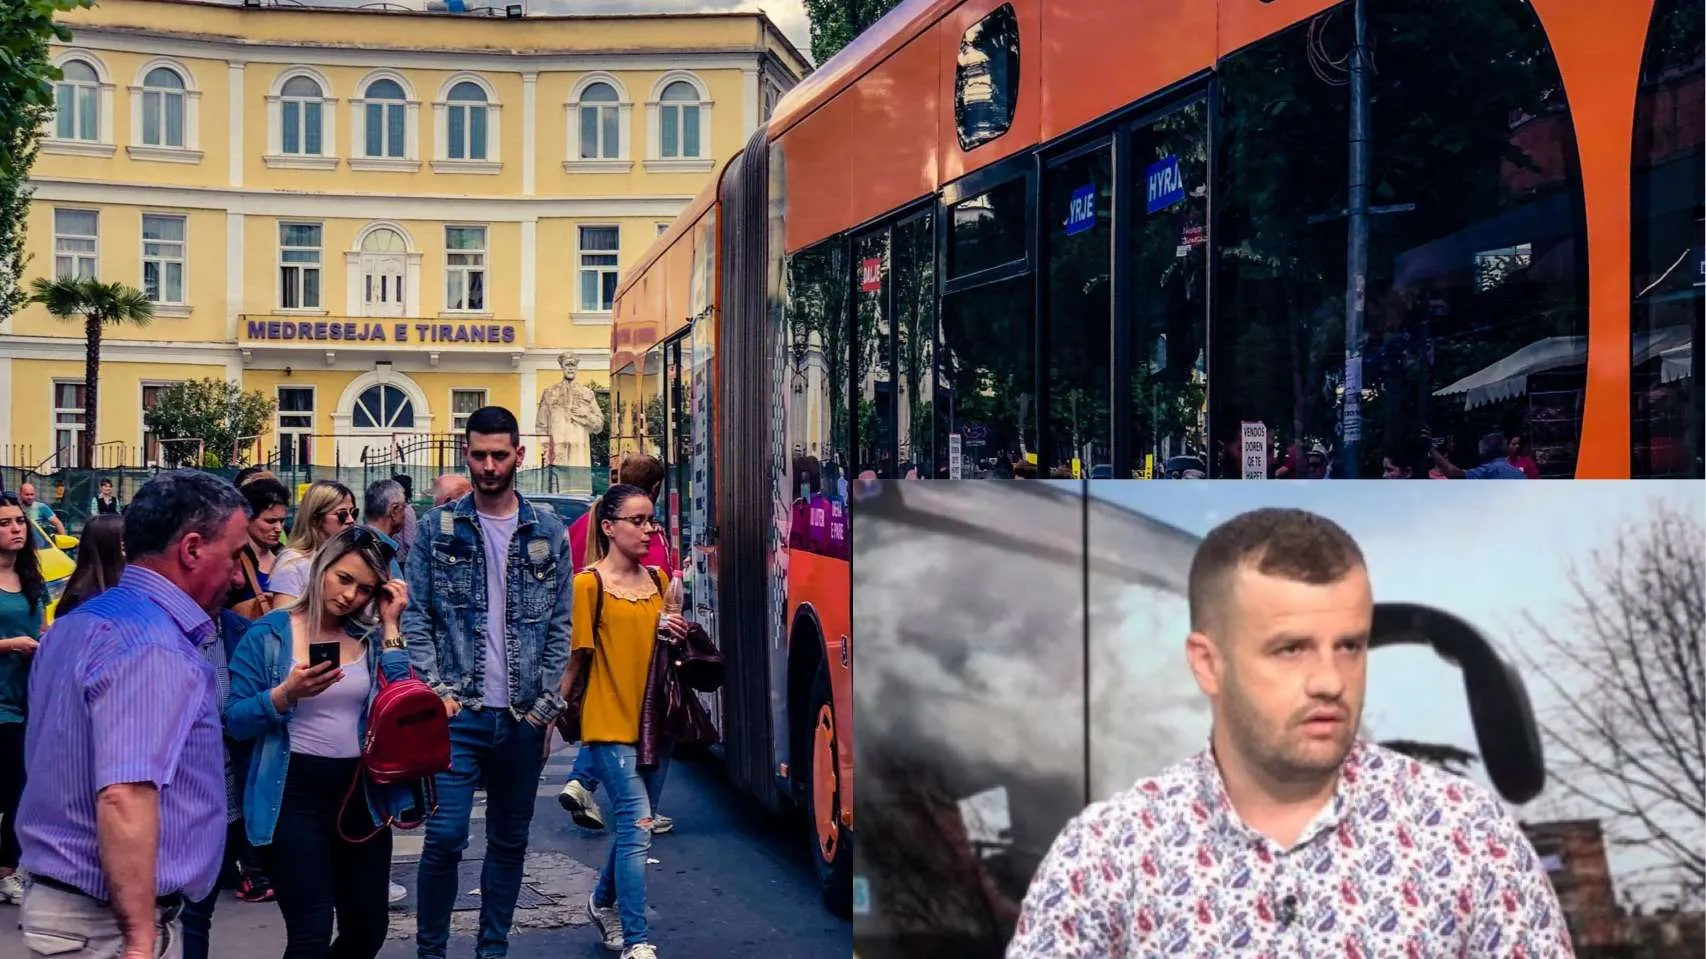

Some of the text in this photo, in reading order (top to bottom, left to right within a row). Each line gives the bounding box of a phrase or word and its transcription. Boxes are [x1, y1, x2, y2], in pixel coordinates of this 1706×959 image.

[1063, 193, 1094, 226] YRJE
[248, 321, 515, 342] MEDRESEJA E TIRANES
[1244, 427, 1265, 437] VENDOS
